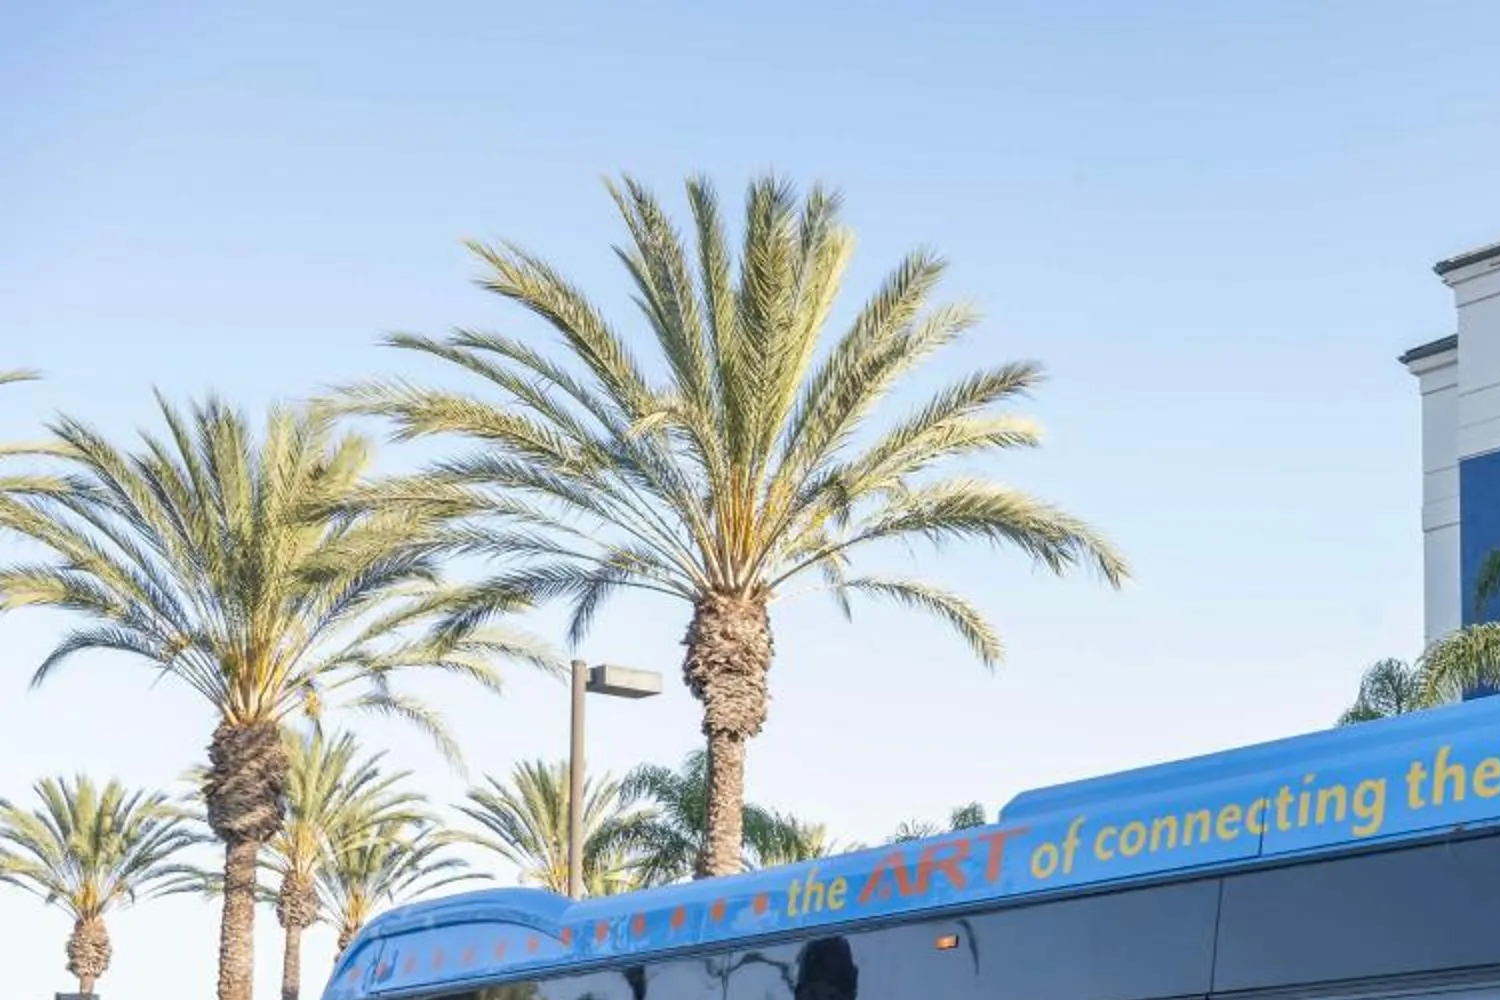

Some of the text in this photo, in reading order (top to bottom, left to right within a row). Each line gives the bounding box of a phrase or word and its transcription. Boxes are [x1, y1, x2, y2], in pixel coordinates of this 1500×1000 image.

[786, 866, 848, 918] the
[857, 826, 1032, 906] ART
[1029, 815, 1087, 880] of
[1093, 772, 1388, 862] connecting
